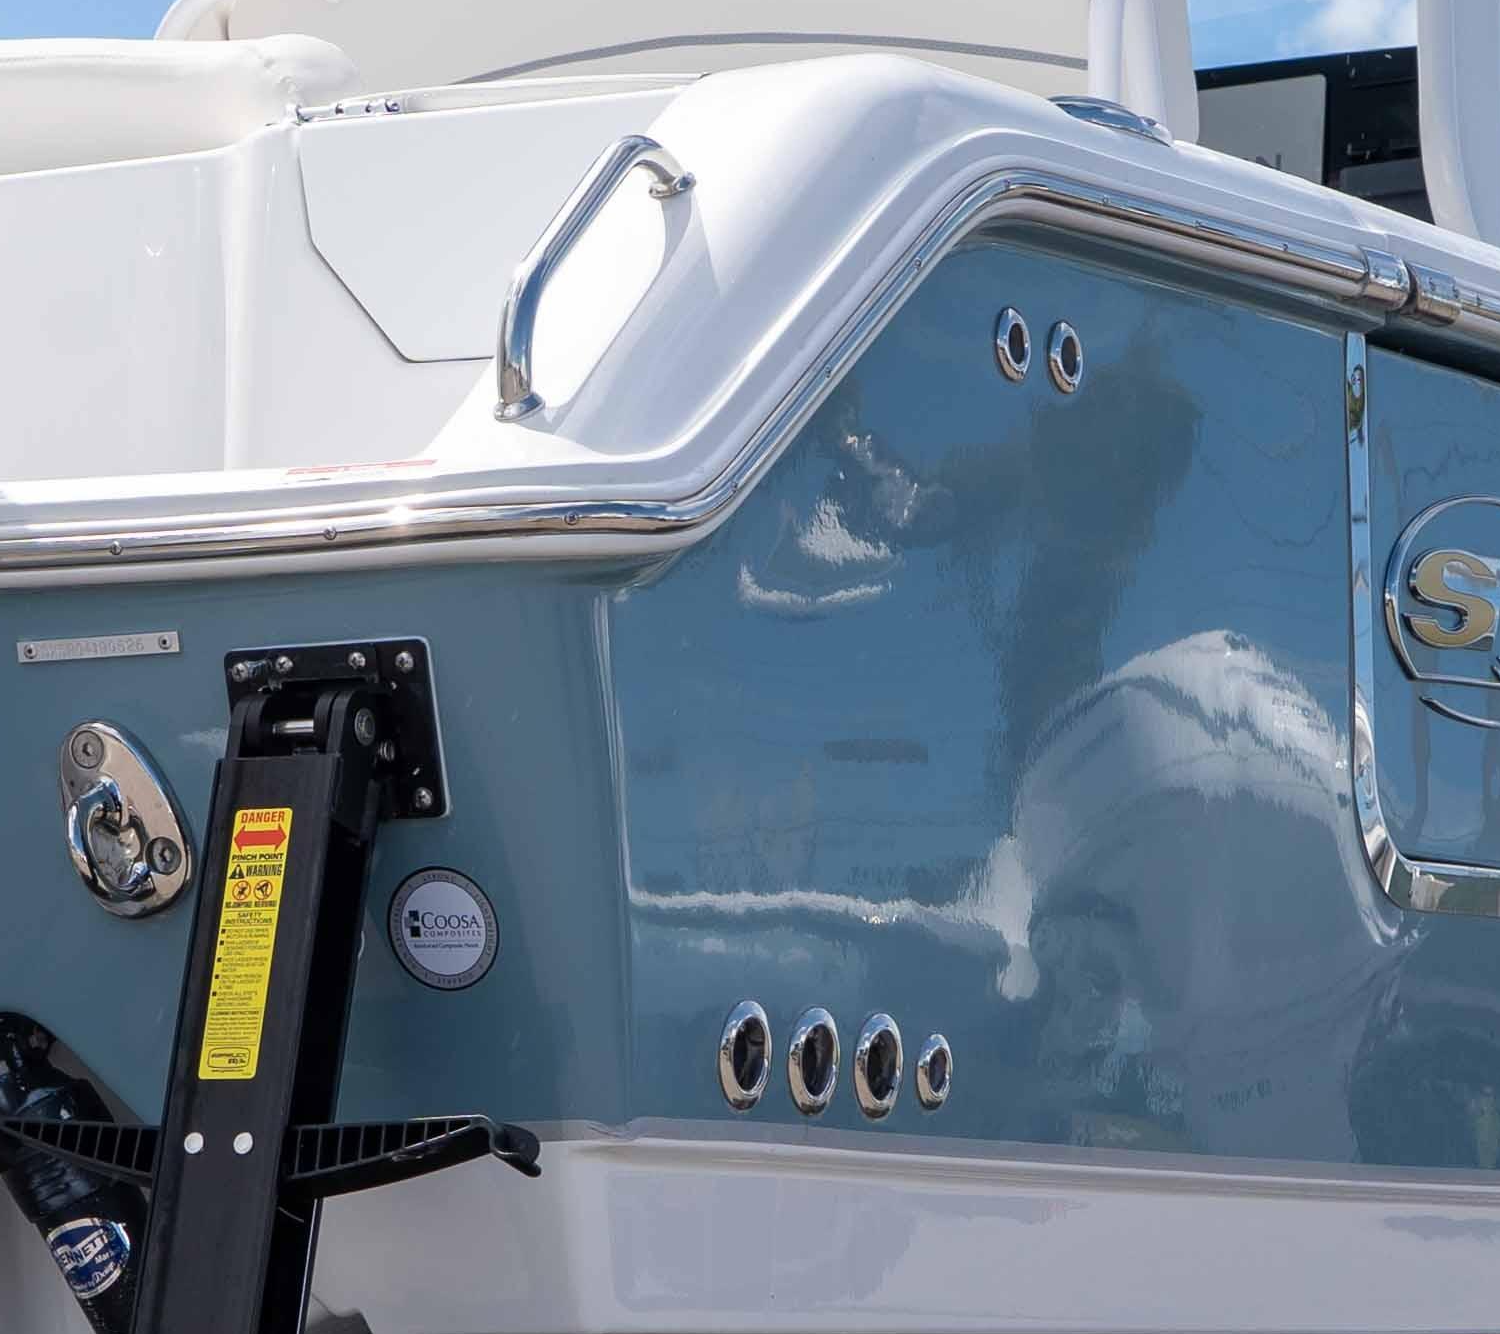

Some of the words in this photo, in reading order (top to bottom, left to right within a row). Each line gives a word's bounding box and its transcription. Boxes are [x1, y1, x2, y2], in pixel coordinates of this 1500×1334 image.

[241, 811, 286, 824] DANGER
[258, 852, 284, 860] POINT
[246, 864, 283, 877] WARNING
[421, 911, 481, 930] COOSA
[424, 930, 481, 938] COMPOSITES
[56, 1231, 109, 1270] ENNETT
